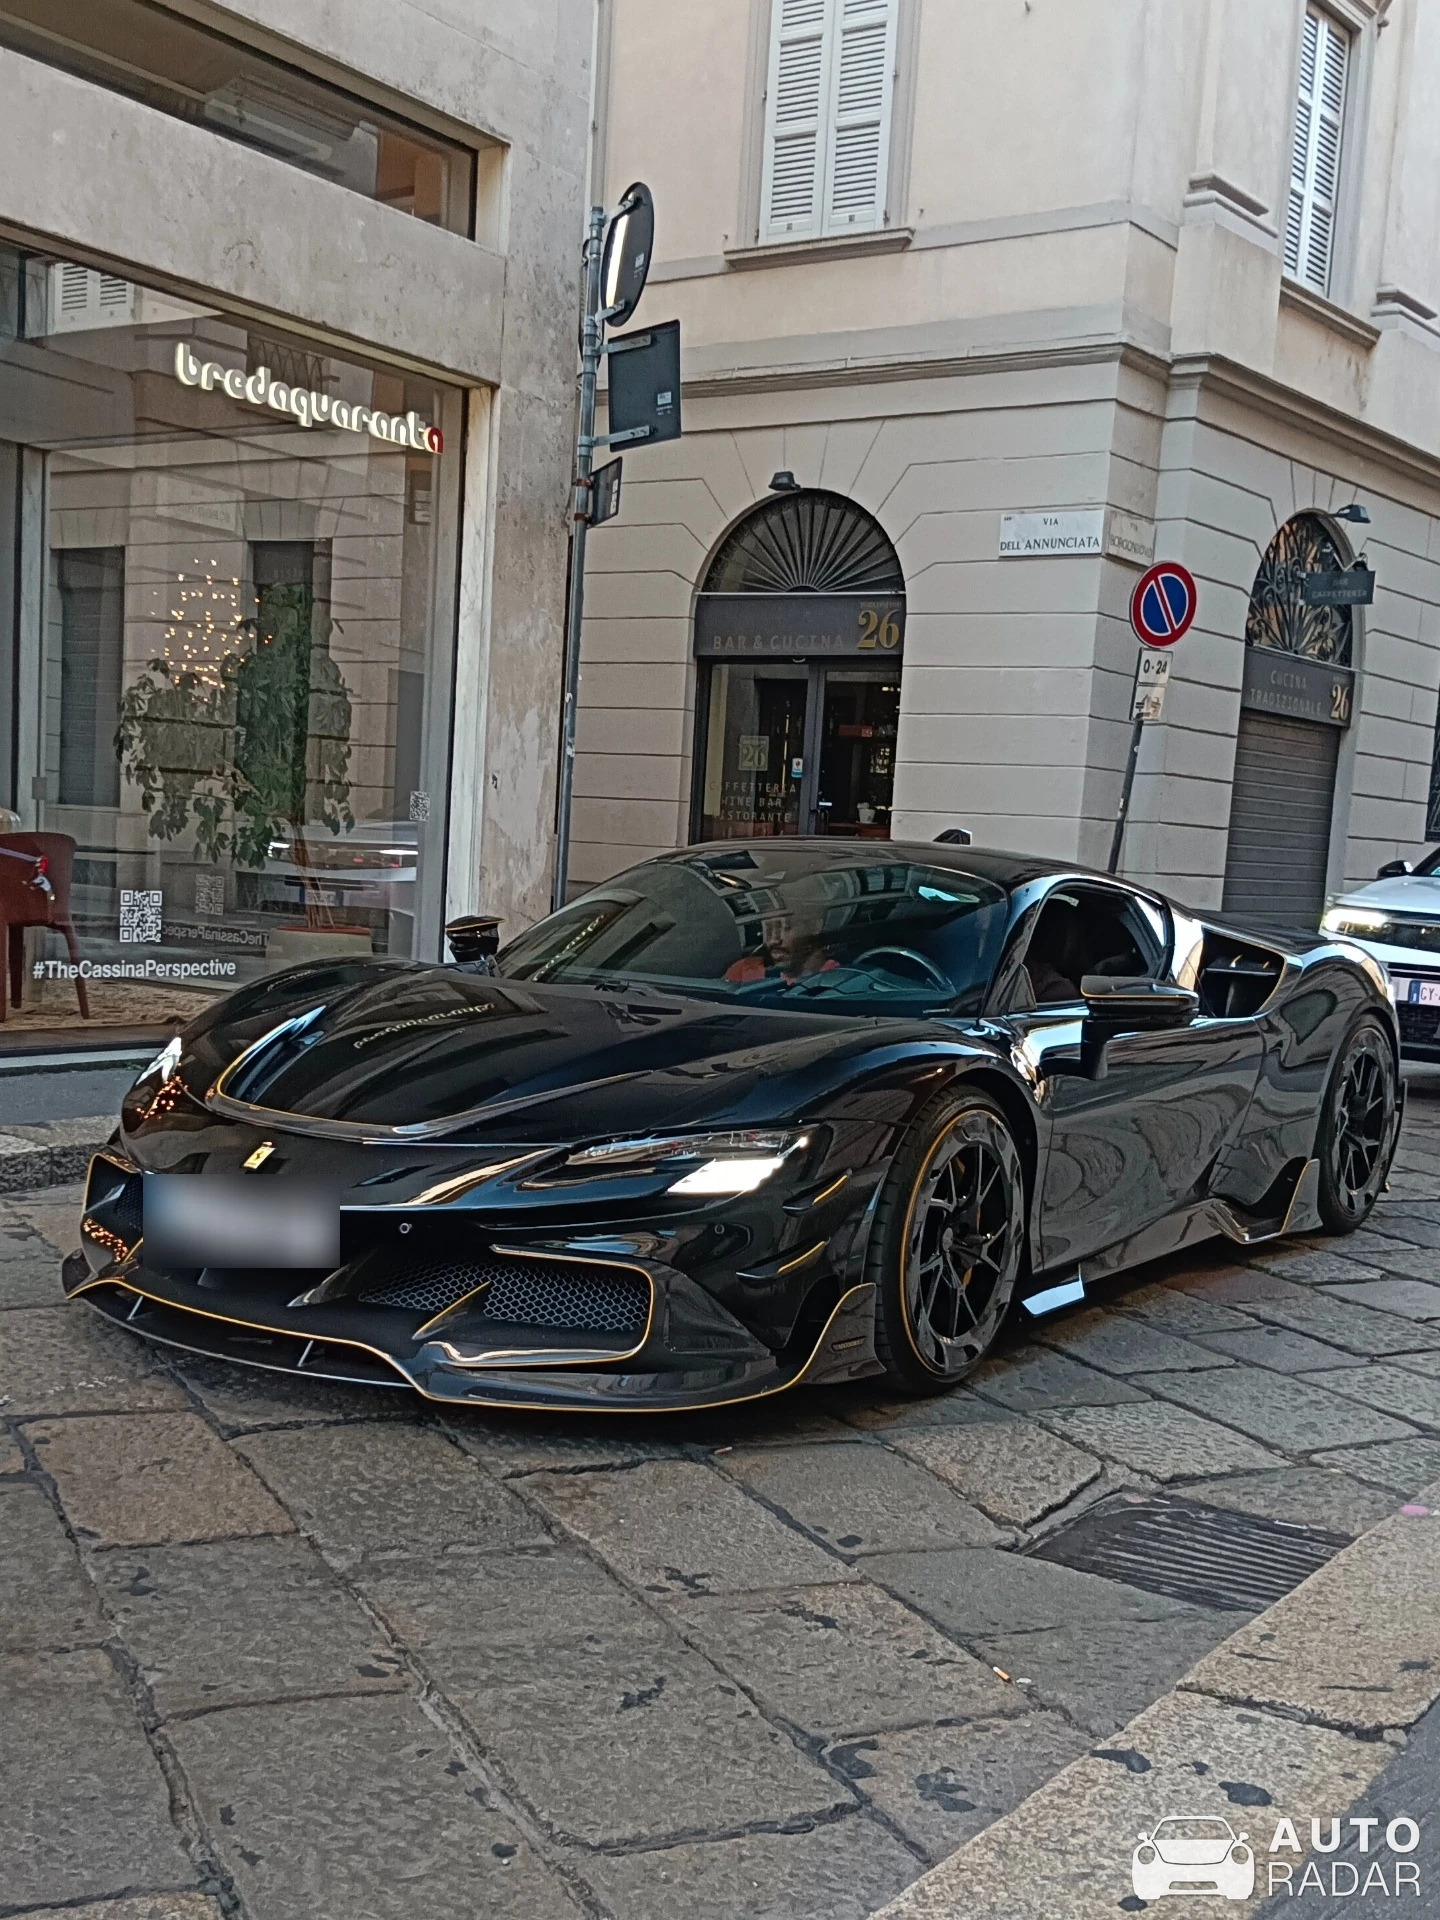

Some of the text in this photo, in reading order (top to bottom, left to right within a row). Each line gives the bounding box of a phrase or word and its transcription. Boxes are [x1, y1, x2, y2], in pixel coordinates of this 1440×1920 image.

[175, 342, 444, 455] bredaquaranta
[1043, 518, 1059, 526] VIA
[857, 609, 900, 649] 26
[713, 635, 844, 650] BAR & CUCINA
[1330, 684, 1350, 720] 26
[742, 744, 767, 769] 26
[710, 781, 796, 793] CFFETTERIA
[759, 798, 782, 808] BAR
[33, 959, 236, 979] #TheCassinaPerspective
